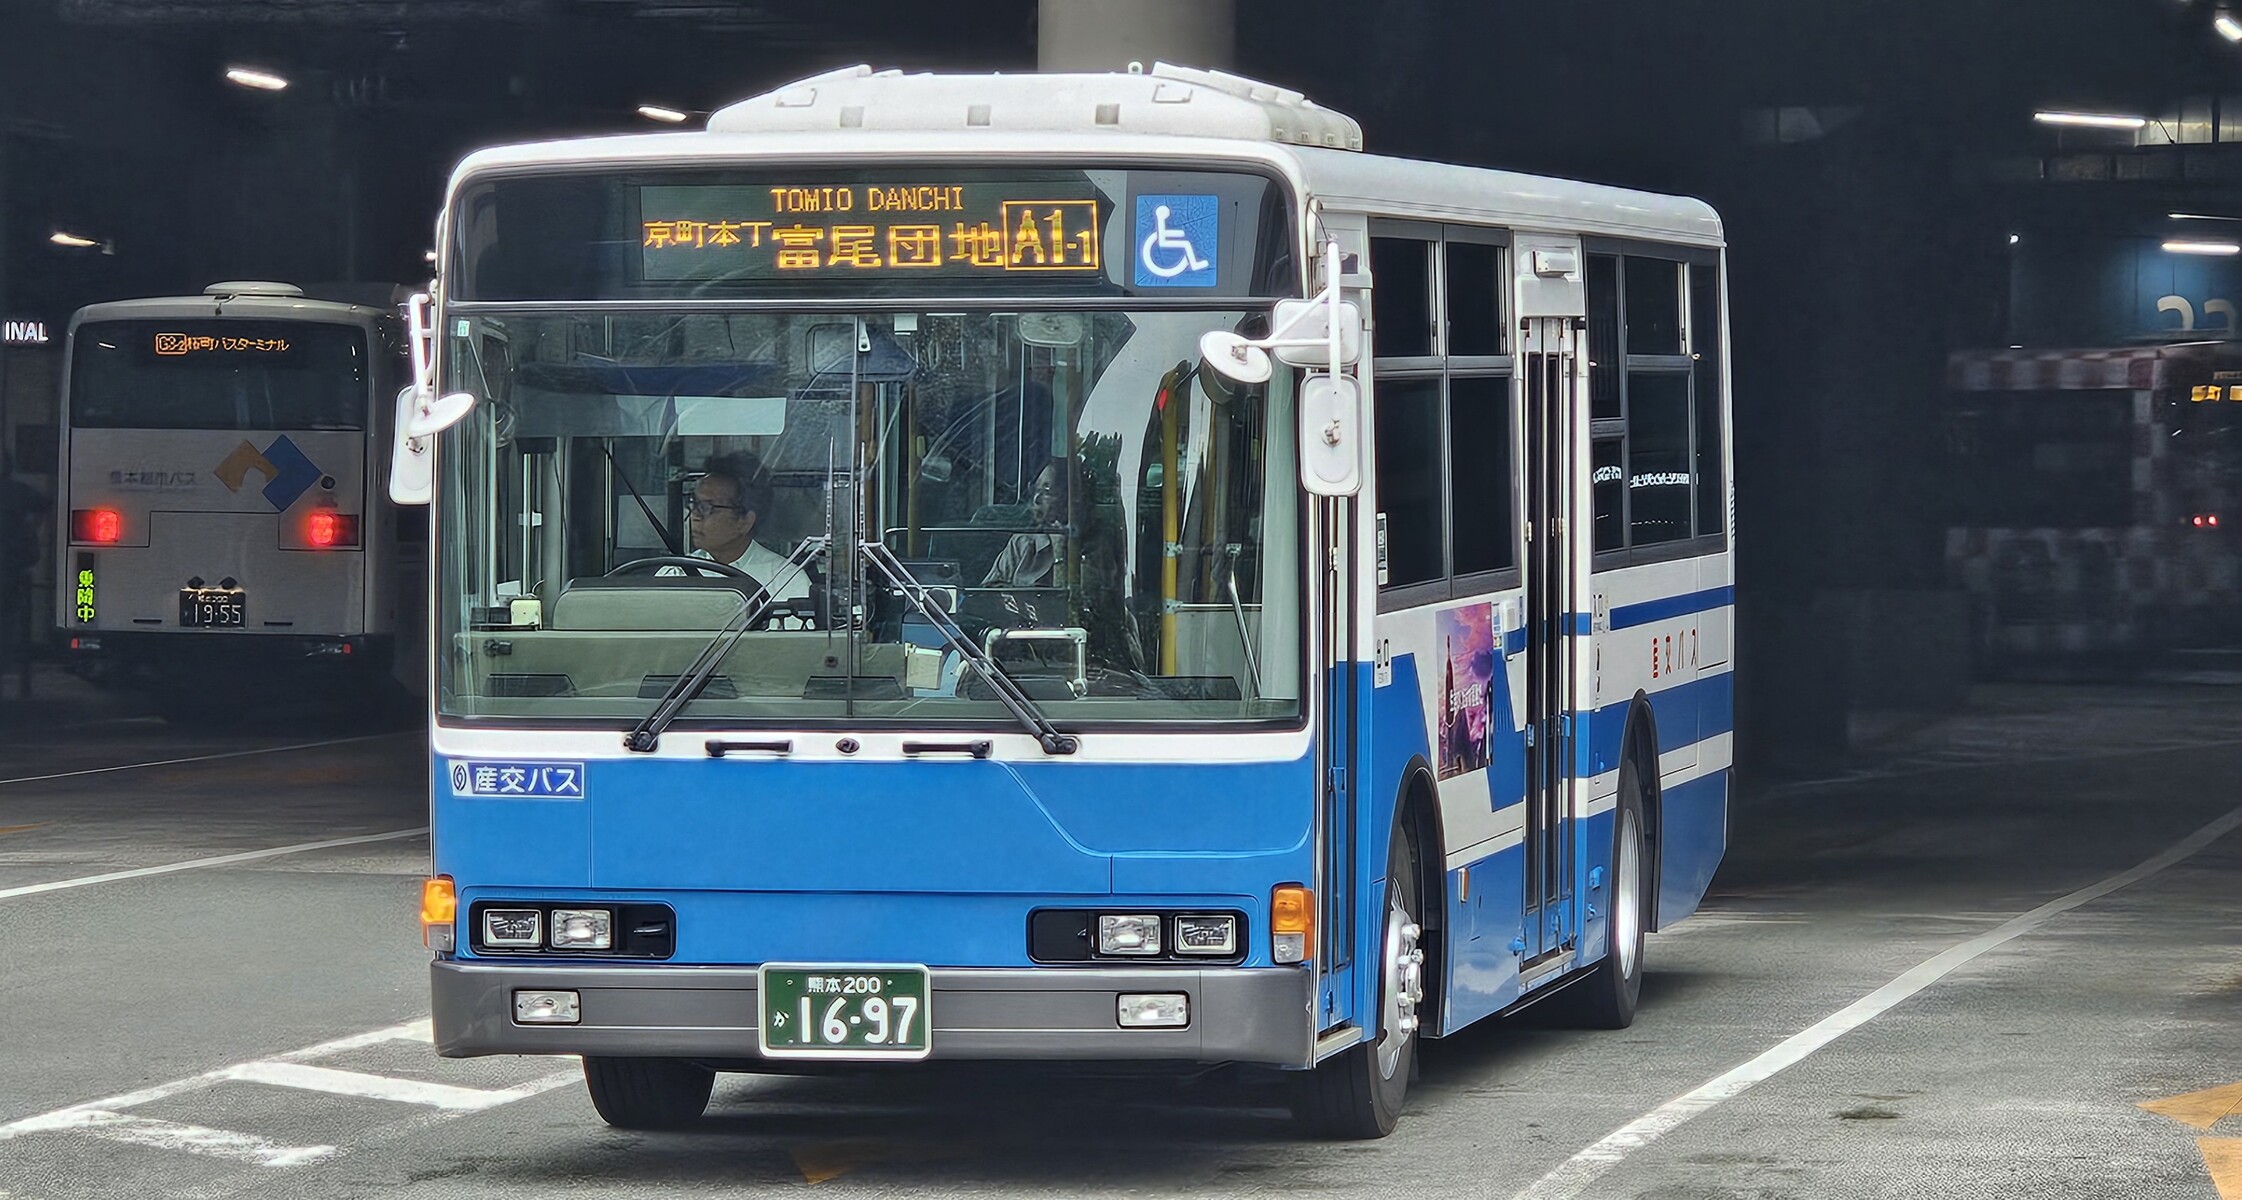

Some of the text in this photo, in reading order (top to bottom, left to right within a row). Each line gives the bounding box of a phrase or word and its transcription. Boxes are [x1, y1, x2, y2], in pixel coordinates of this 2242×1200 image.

[770, 186, 963, 212] TOMIO DANCHI
[644, 220, 773, 248] 京町本丁
[772, 222, 1003, 268] 富尾団地
[5, 321, 49, 341] INAL
[474, 765, 580, 793] 産交バス
[801, 996, 918, 1044] 16-97
